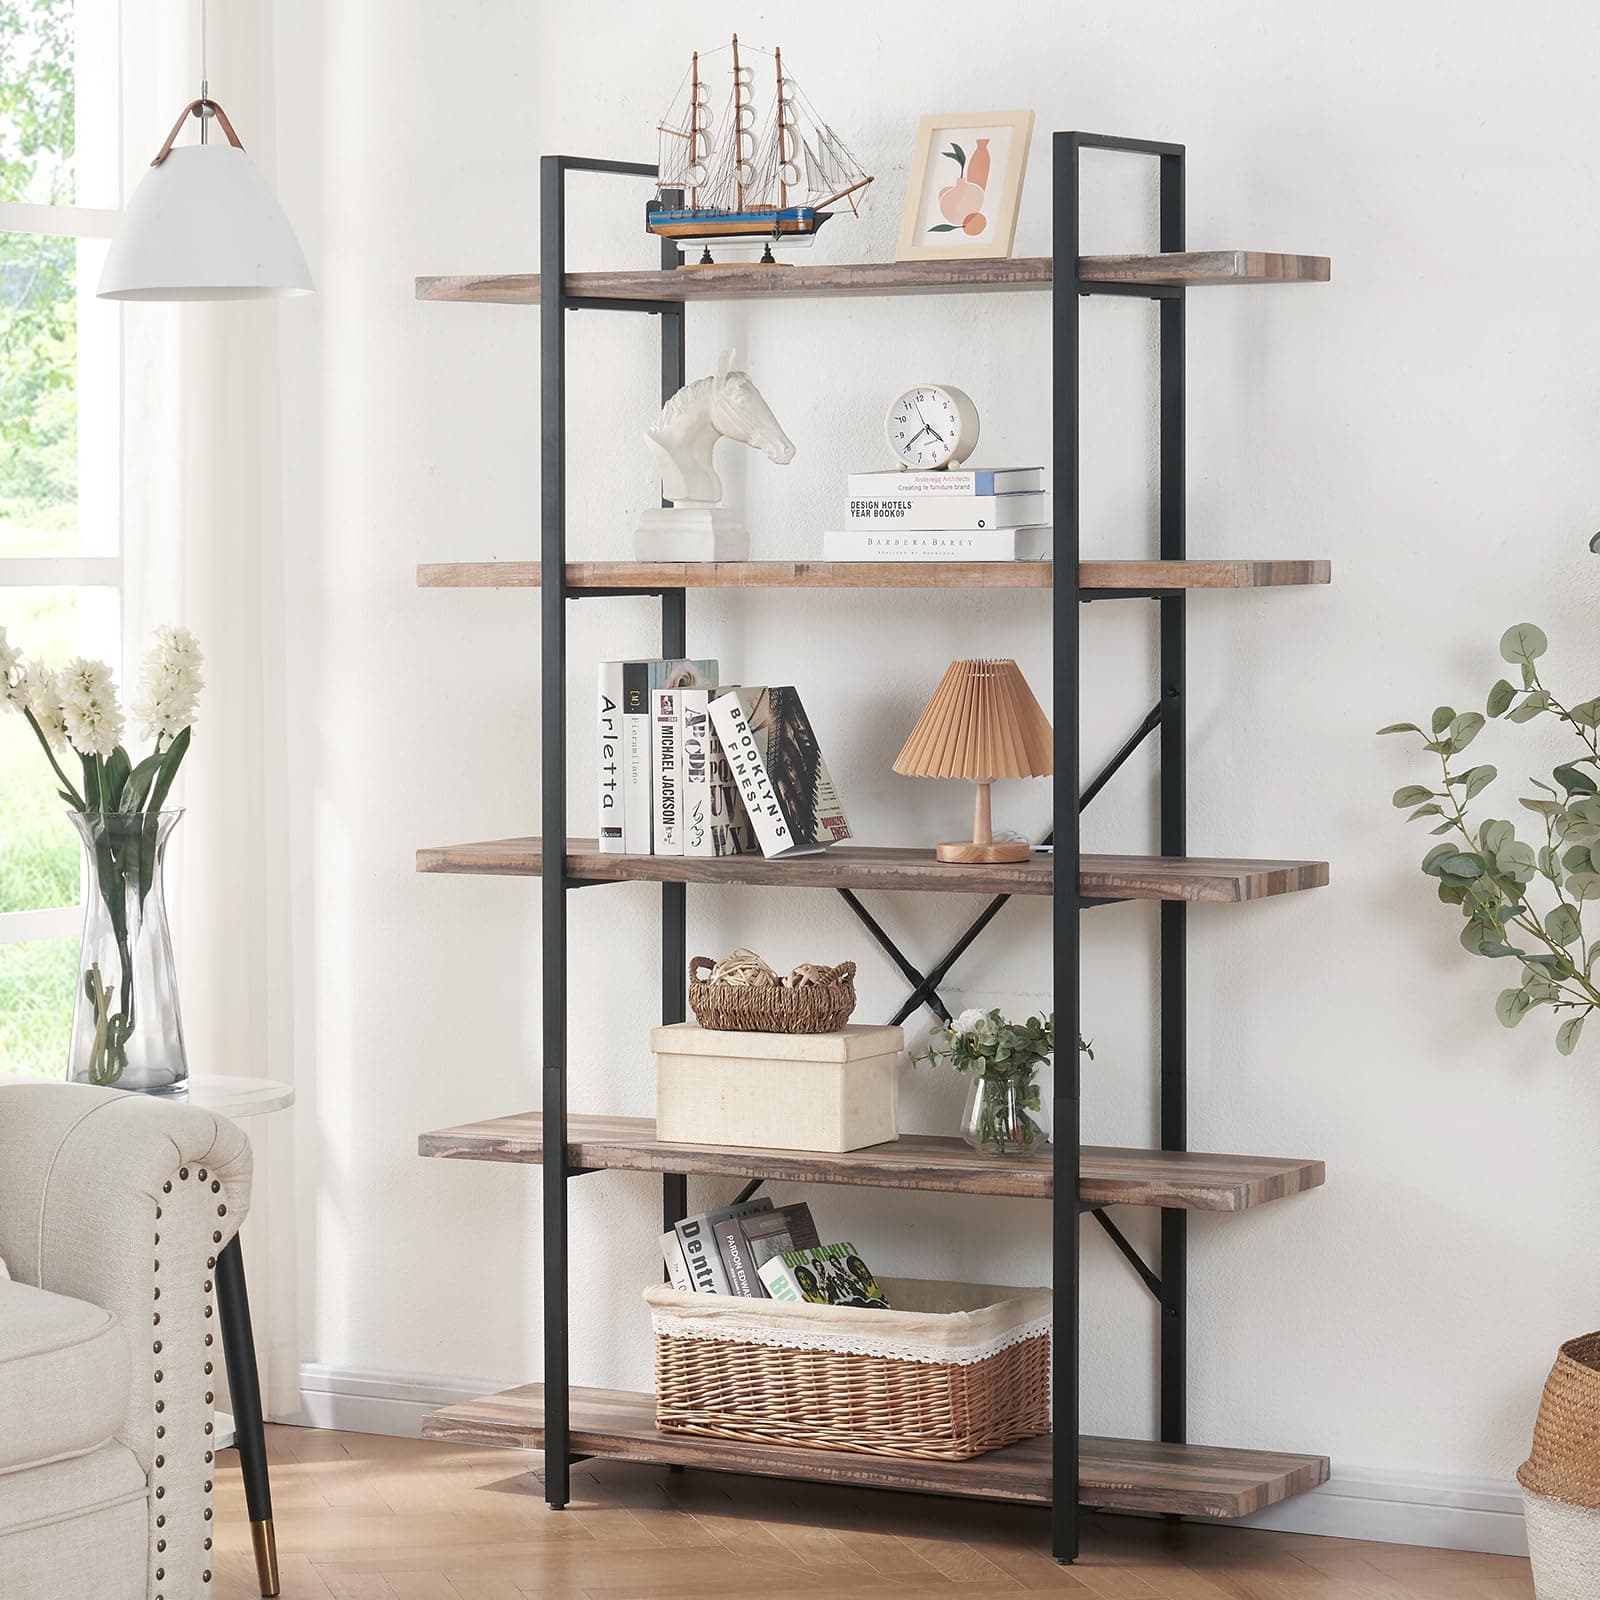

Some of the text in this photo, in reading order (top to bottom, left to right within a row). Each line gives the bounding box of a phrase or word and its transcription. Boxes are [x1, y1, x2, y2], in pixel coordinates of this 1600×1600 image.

[916, 394, 924, 402] 12
[899, 415, 907, 423] 10
[899, 431, 905, 439] 9
[943, 443, 949, 452] 5
[917, 452, 923, 460] 7
[942, 475, 970, 483] Architects
[898, 484, 922, 492] Creating
[850, 500, 912, 510] DESIGN HOTELS
[850, 509, 905, 518] YEAR BOOK09
[867, 537, 927, 546] BARBERA
[601, 694, 619, 809] Arletta
[661, 725, 675, 773] MICHAEL
[730, 707, 786, 838] BROOKLYN'S
[727, 741, 763, 815] FINEST
[661, 775, 676, 825] JACKSON
[726, 1234, 744, 1271] PARDON
